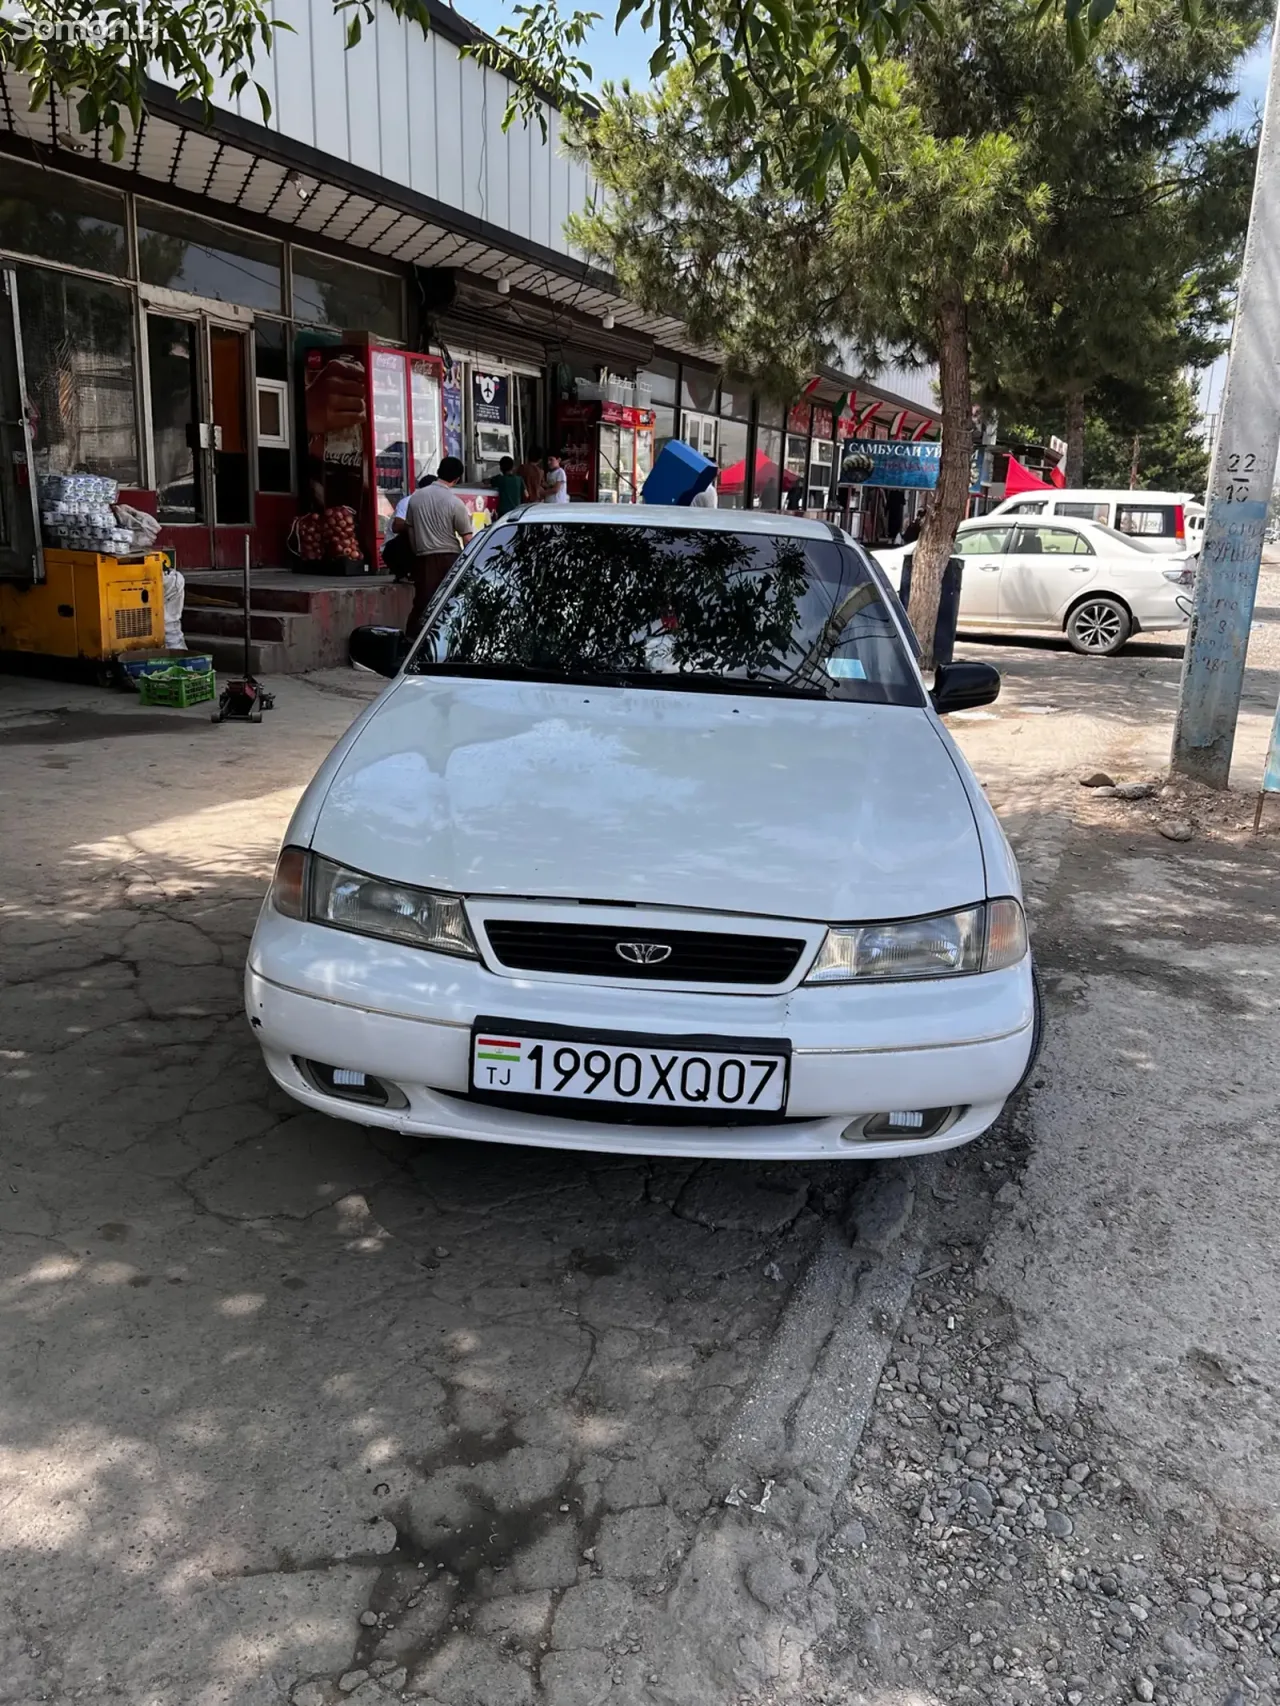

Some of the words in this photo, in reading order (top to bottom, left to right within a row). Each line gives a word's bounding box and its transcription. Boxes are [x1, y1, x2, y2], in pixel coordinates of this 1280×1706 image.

[1227, 453, 1256, 473] 22
[1226, 484, 1249, 505] 10
[486, 1066, 511, 1086] TJ
[527, 1044, 779, 1105] 1990XQ07
